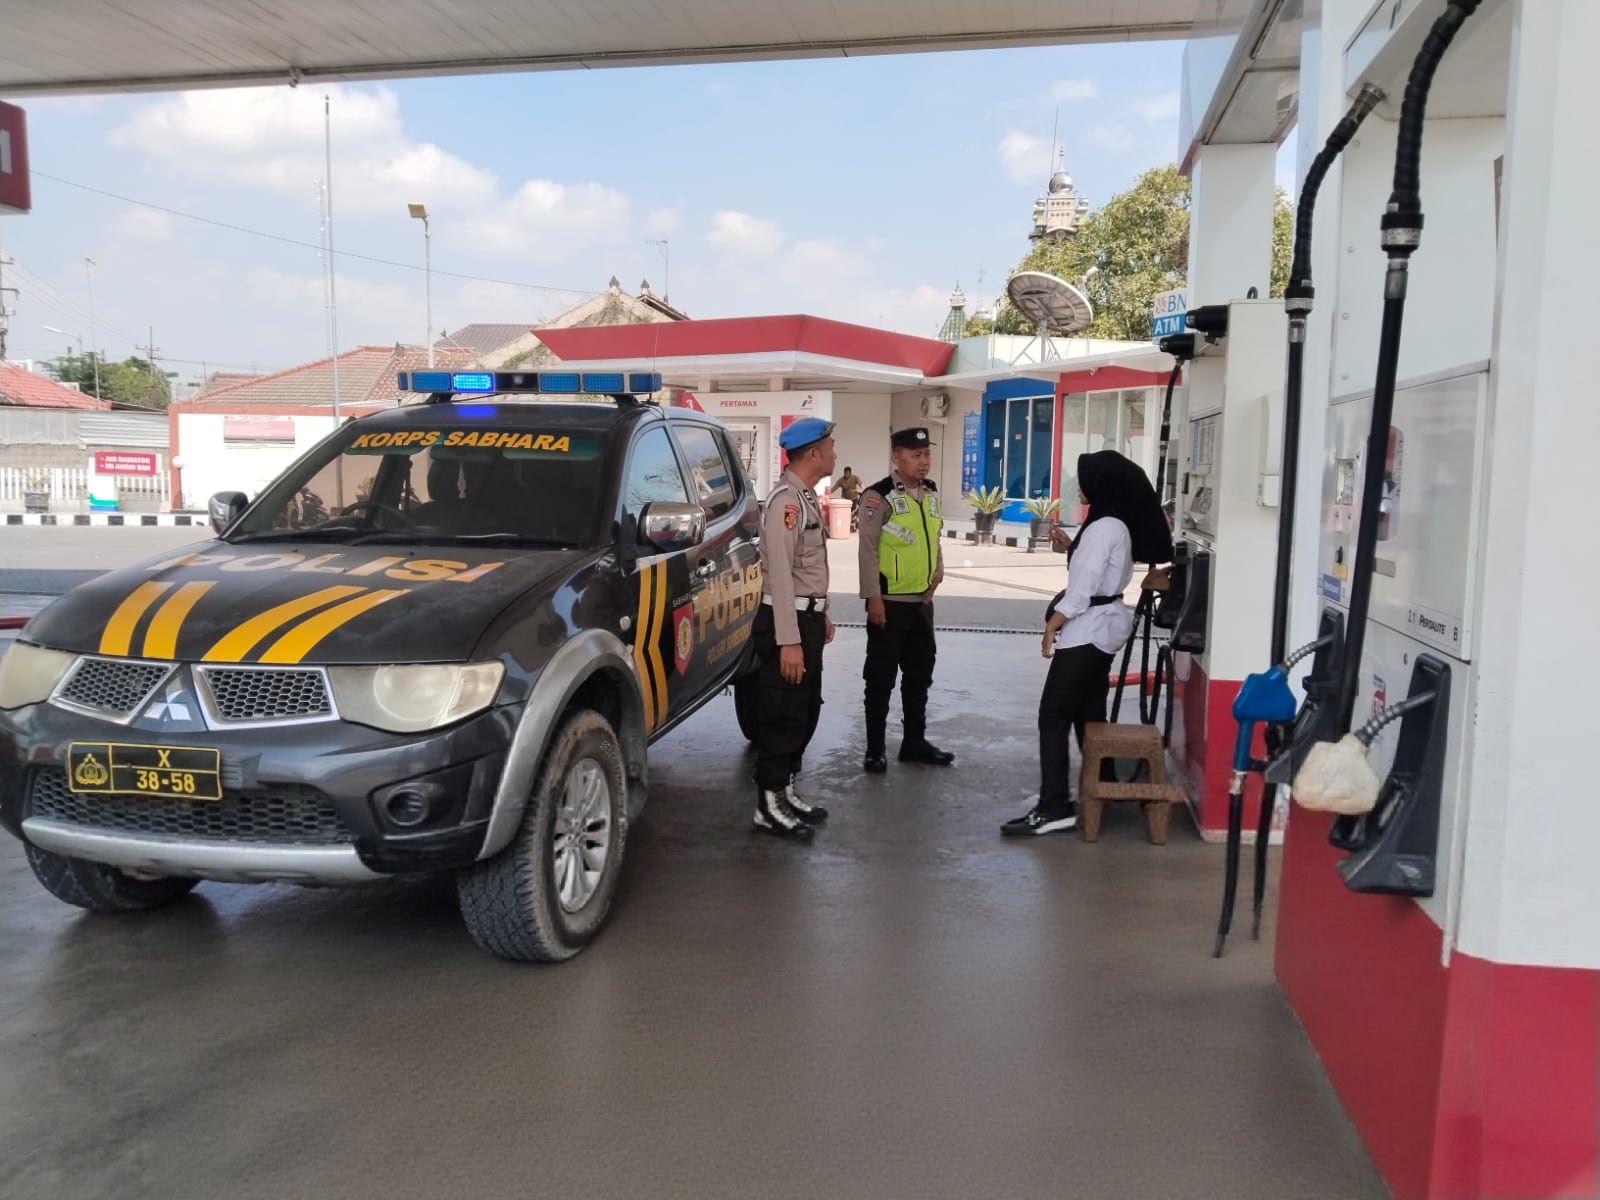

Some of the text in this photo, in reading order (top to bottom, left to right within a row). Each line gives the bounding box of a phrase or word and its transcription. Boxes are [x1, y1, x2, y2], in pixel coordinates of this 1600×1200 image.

[1154, 316, 1181, 335] ATM
[720, 400, 758, 408] PERTAMAX
[350, 430, 571, 452] KORPS SABHARA
[145, 552, 504, 583] POLISI
[158, 749, 171, 768] X
[136, 770, 195, 794] 38-58
